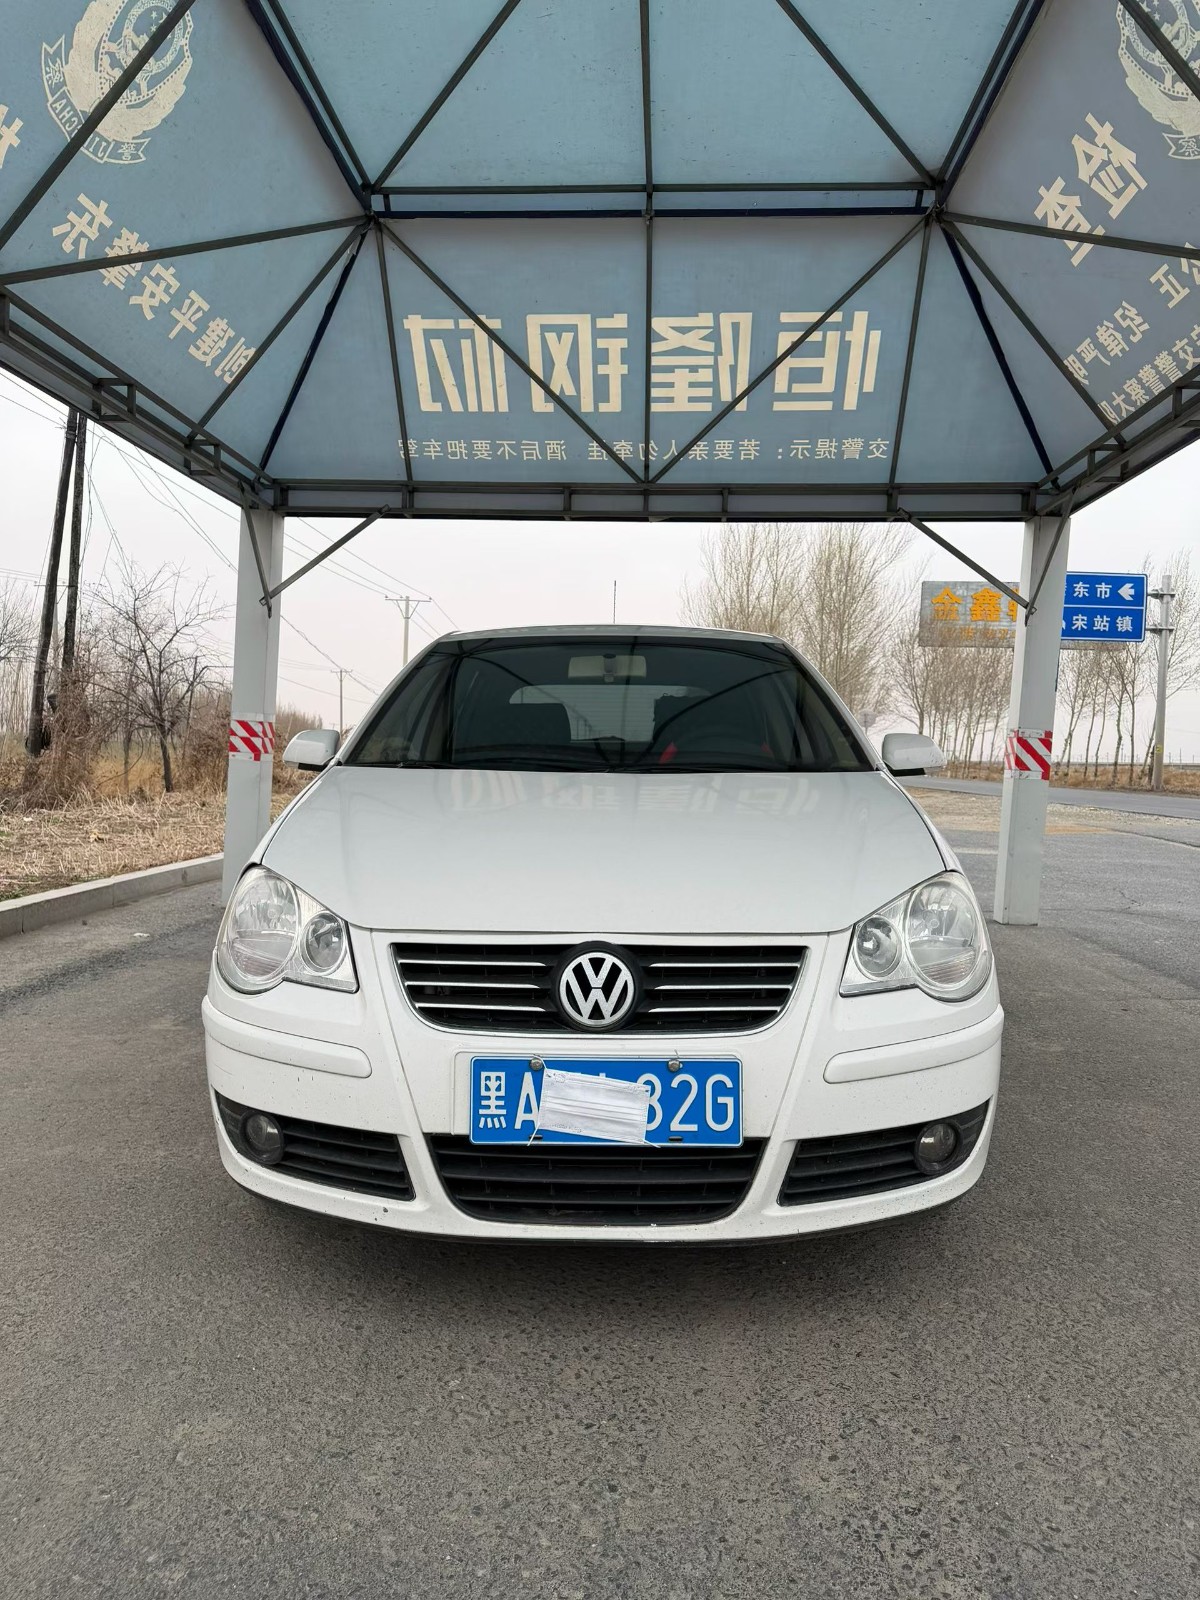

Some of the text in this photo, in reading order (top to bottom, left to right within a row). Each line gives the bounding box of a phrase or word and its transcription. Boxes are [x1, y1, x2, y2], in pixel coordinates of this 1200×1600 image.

[1064, 582, 1112, 600] 东市
[1071, 614, 1133, 632] 宋站镇
